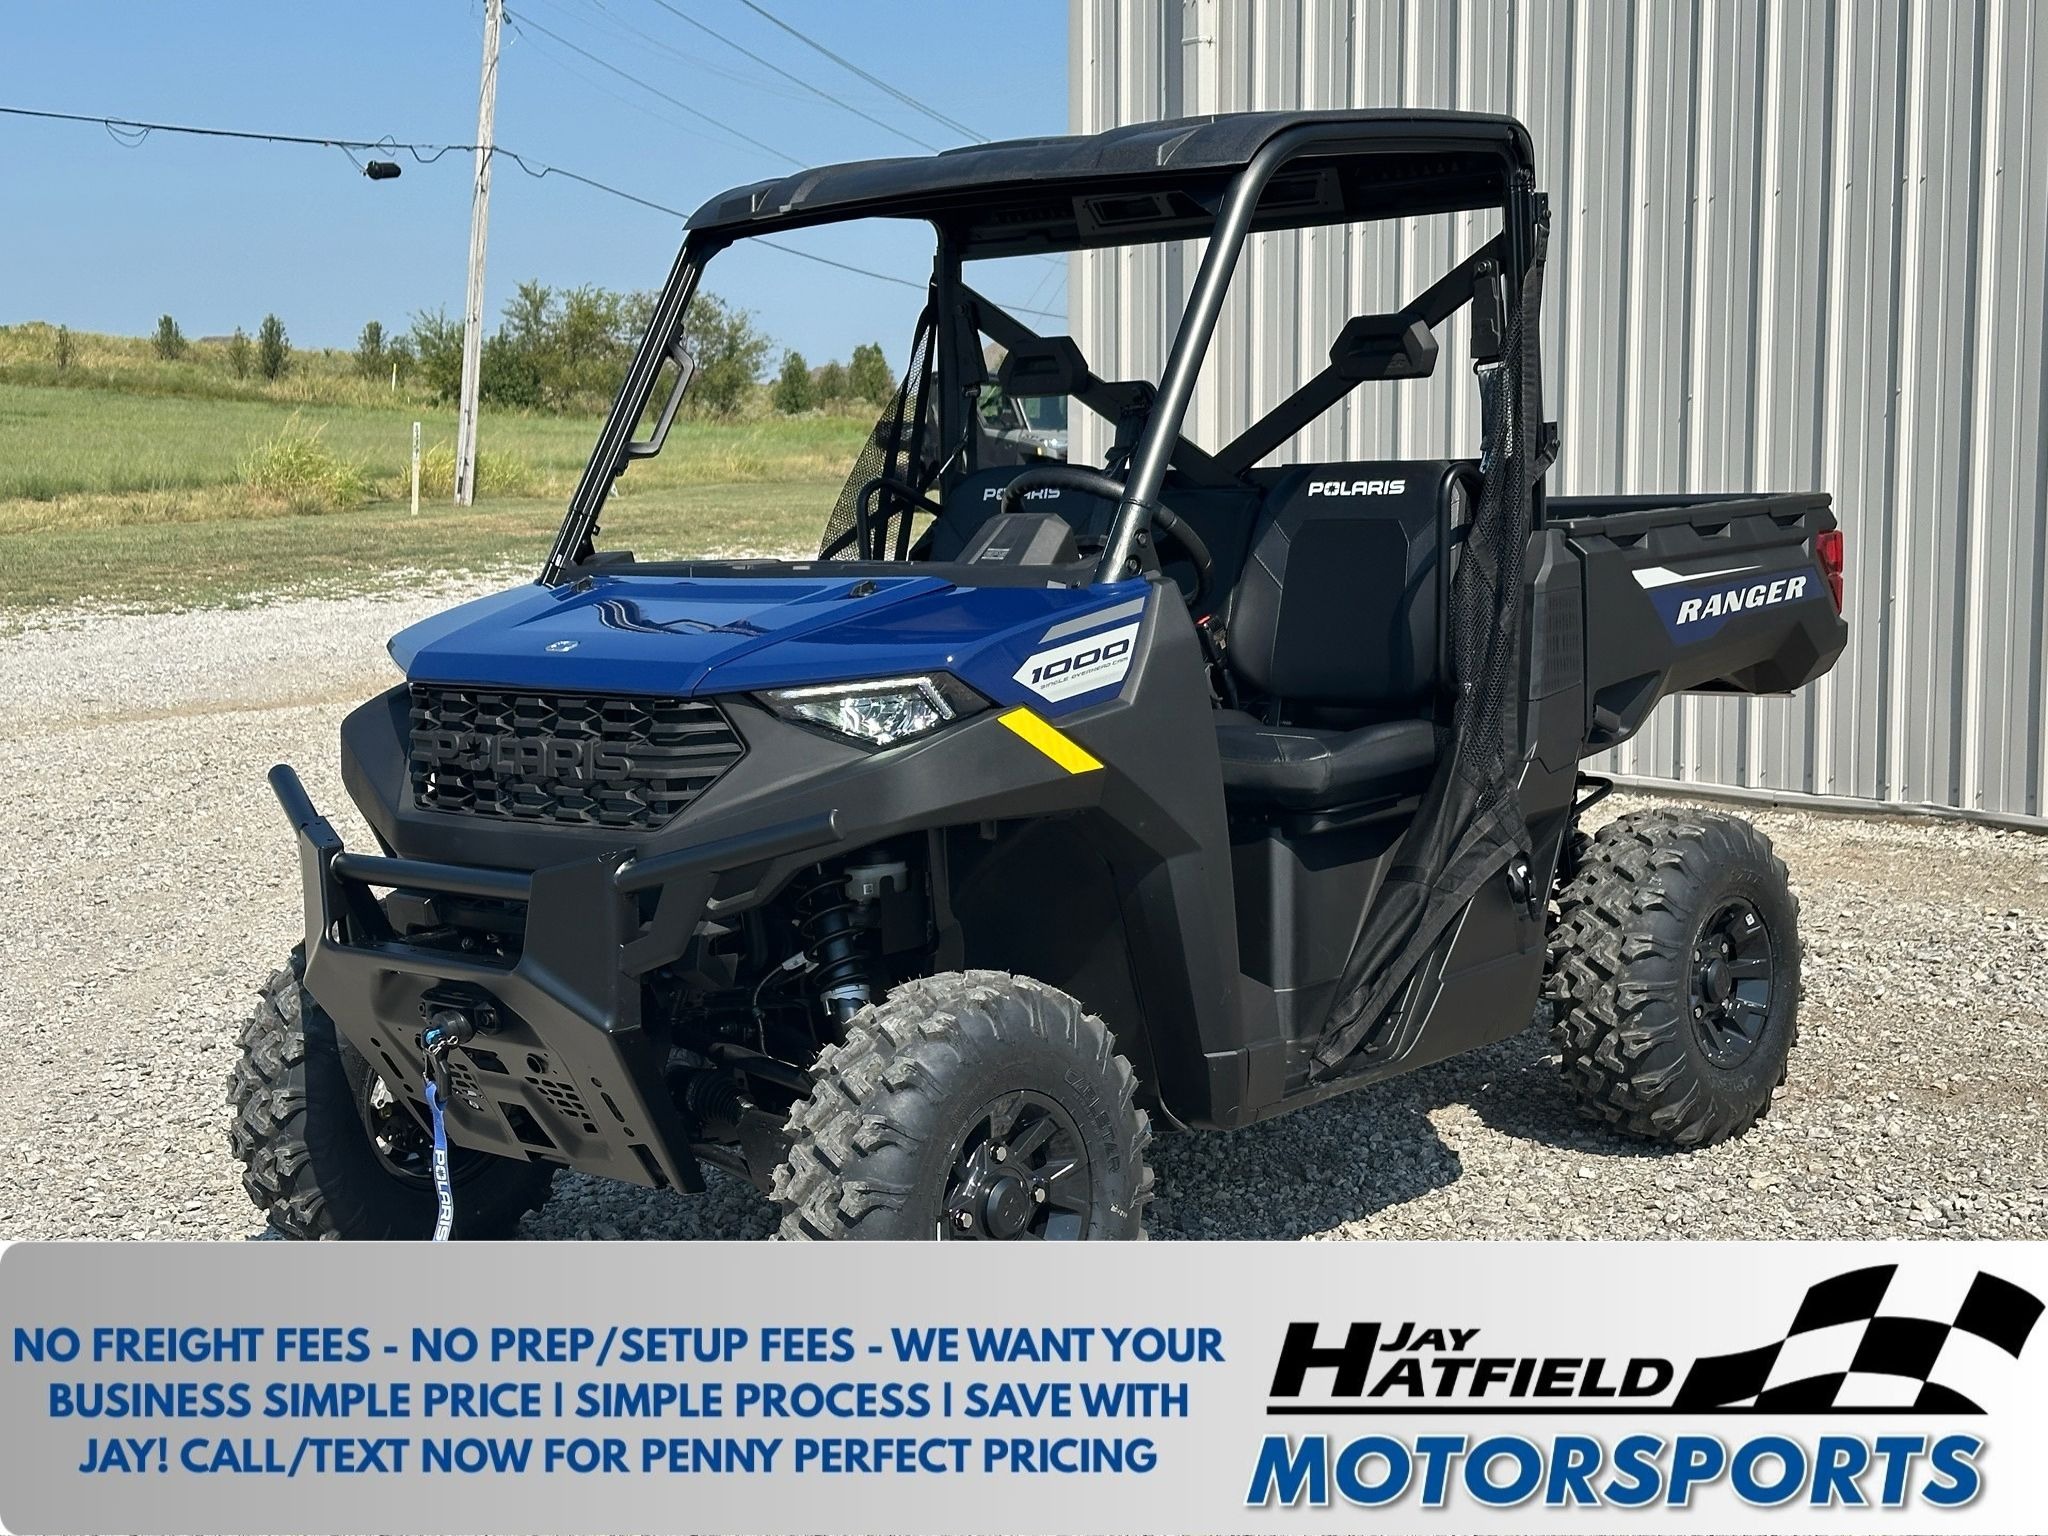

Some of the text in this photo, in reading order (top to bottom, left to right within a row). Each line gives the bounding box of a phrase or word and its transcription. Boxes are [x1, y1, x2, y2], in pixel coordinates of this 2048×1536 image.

[1308, 479, 1406, 497] POLARIS
[1676, 575, 1807, 625] RANGER
[1031, 639, 1130, 684] 1000
[432, 730, 634, 781] POLARIS
[434, 1150, 453, 1241] POLARIS
